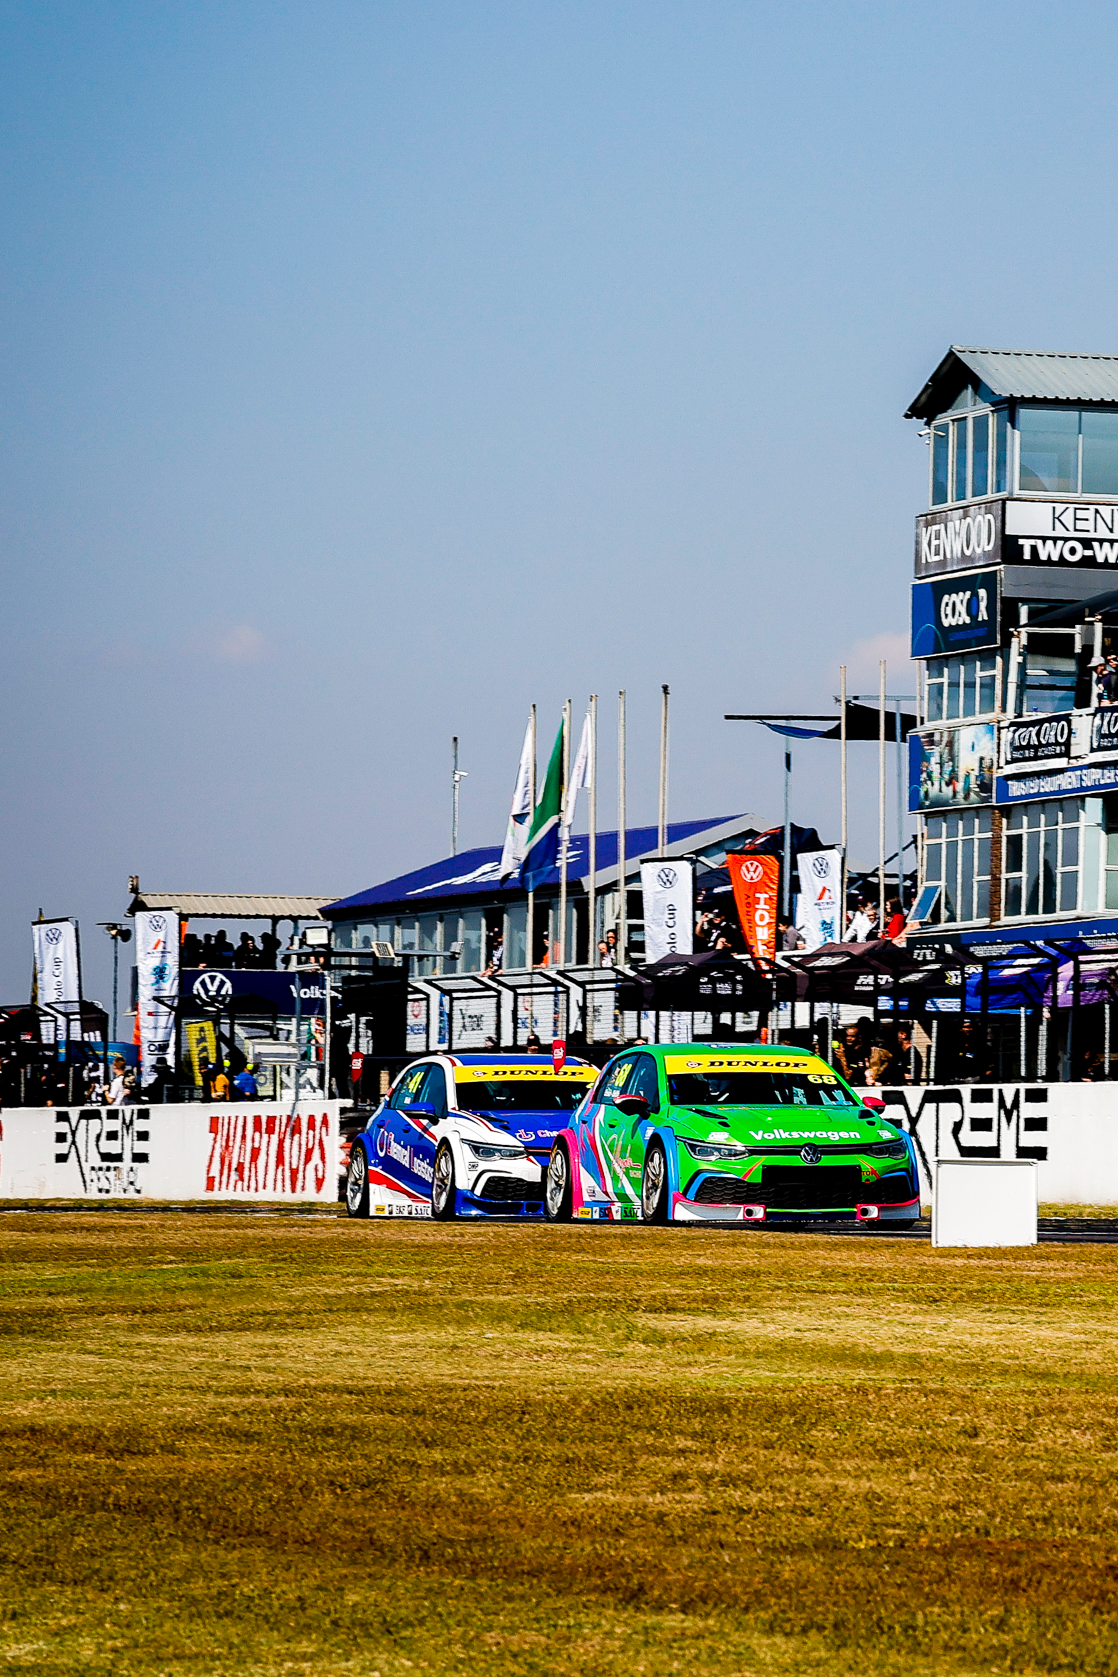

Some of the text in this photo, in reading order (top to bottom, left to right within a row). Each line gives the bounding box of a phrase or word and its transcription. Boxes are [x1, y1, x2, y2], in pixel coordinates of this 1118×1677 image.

[921, 513, 996, 564] KENWOOD
[665, 904, 677, 954] olo Cup
[52, 957, 63, 978] Cup
[707, 1060, 808, 1068] DUNLOP
[807, 1074, 838, 1085] 68
[56, 1108, 149, 1193] EXTREME
[749, 1129, 861, 1141] Volkswagen
[205, 1113, 329, 1193] ZWARTKOPS
